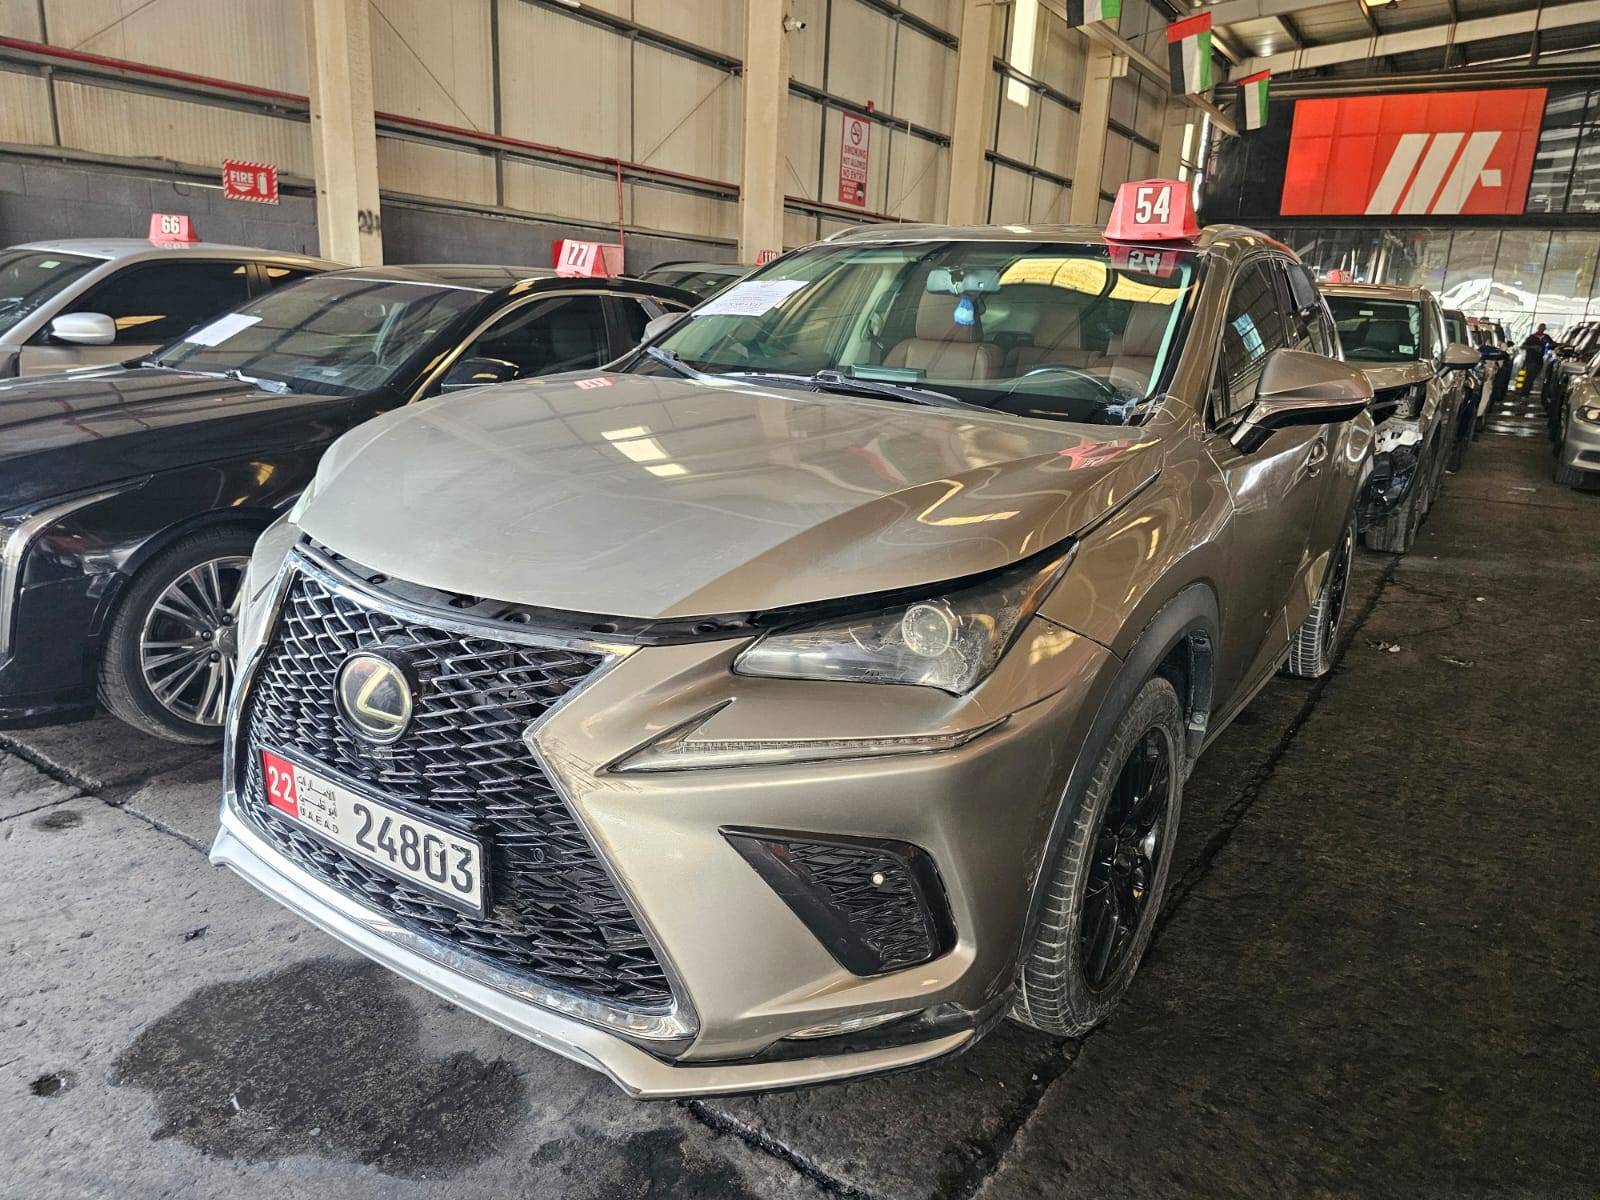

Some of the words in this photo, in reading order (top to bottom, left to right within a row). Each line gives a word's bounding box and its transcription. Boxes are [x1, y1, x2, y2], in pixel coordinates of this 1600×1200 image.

[230, 170, 254, 184] FIRE
[1135, 186, 1171, 223] 54
[162, 215, 180, 234] 66
[568, 243, 589, 266] 77
[267, 765, 294, 804] 22
[352, 803, 473, 894] 24803
